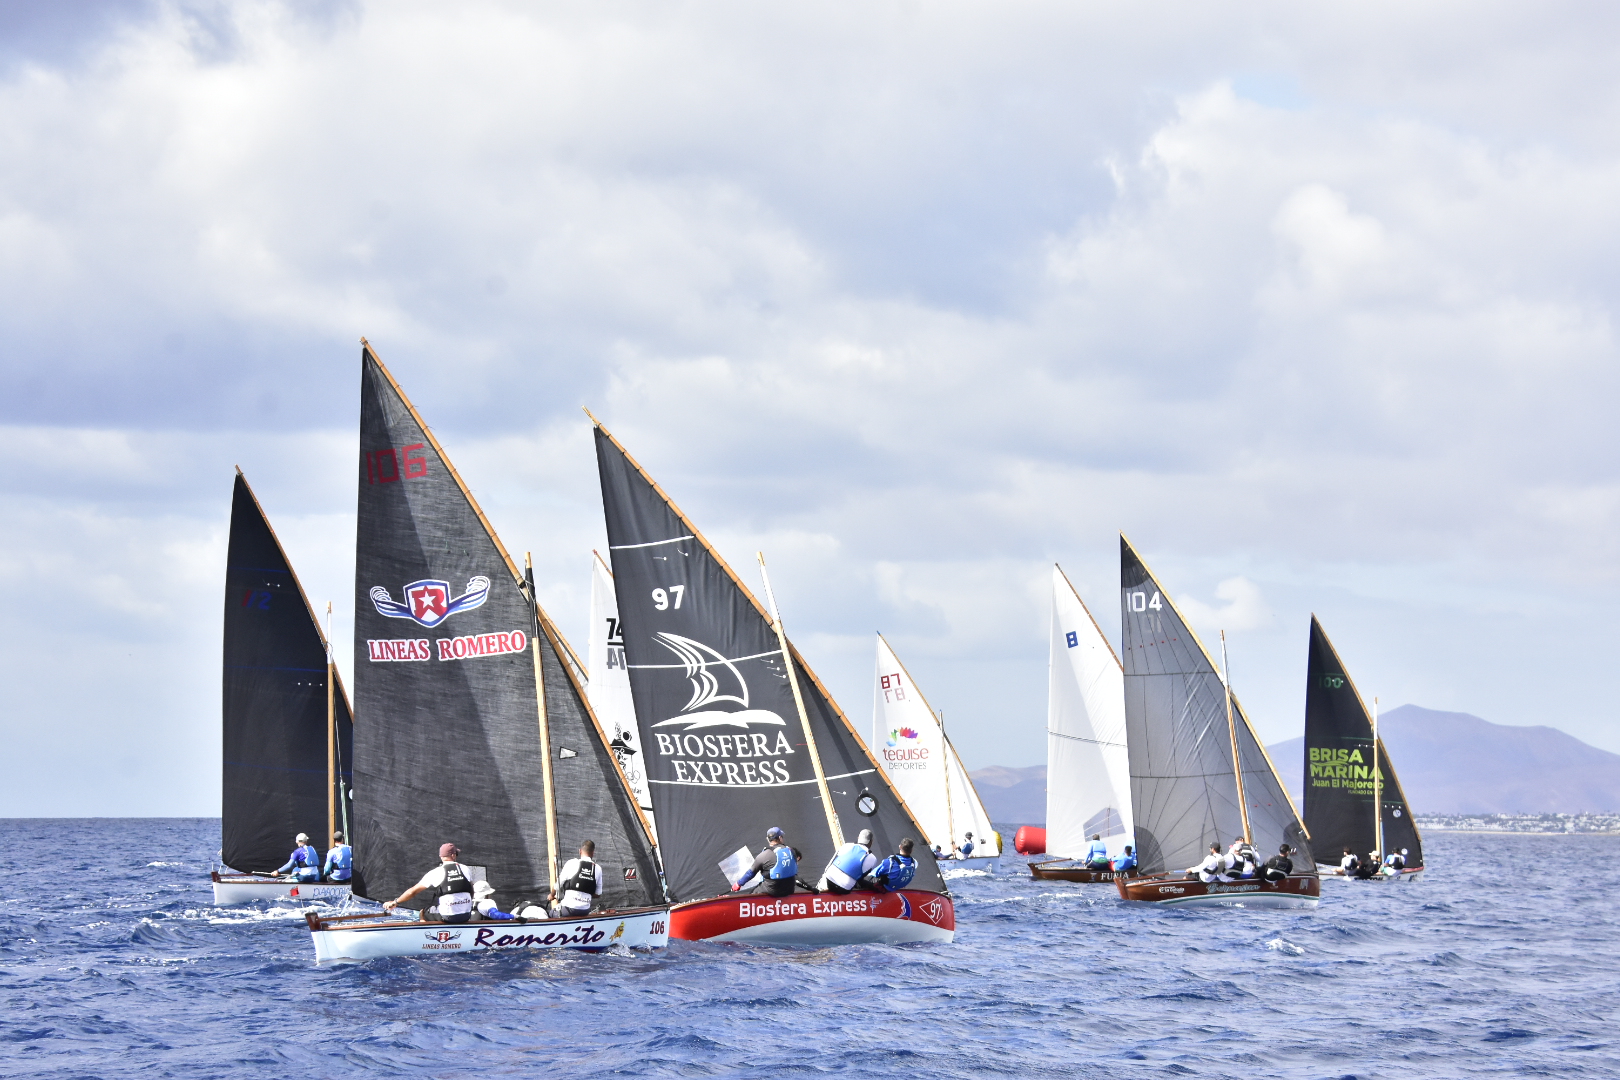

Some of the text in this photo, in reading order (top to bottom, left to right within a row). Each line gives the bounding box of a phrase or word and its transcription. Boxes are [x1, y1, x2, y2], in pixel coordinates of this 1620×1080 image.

[366, 442, 427, 485] 106
[241, 589, 272, 610] 112
[651, 584, 685, 610] 97
[1126, 591, 1162, 612] 104
[367, 629, 527, 662] LINEAS ROMERO
[1065, 630, 1079, 649] 8
[880, 672, 901, 689] 87
[655, 730, 795, 758] BIOSFERA
[1309, 747, 1364, 763] BRISA
[671, 759, 791, 785] EXPRESS
[888, 762, 927, 770] DEPORTES
[1310, 763, 1384, 780] MARINA
[1312, 778, 1384, 789] Juan El Majoreo
[739, 898, 867, 918] Biosfera Express
[930, 902, 942, 919] 97
[474, 925, 605, 947] Romerito
[650, 921, 665, 934] 106
